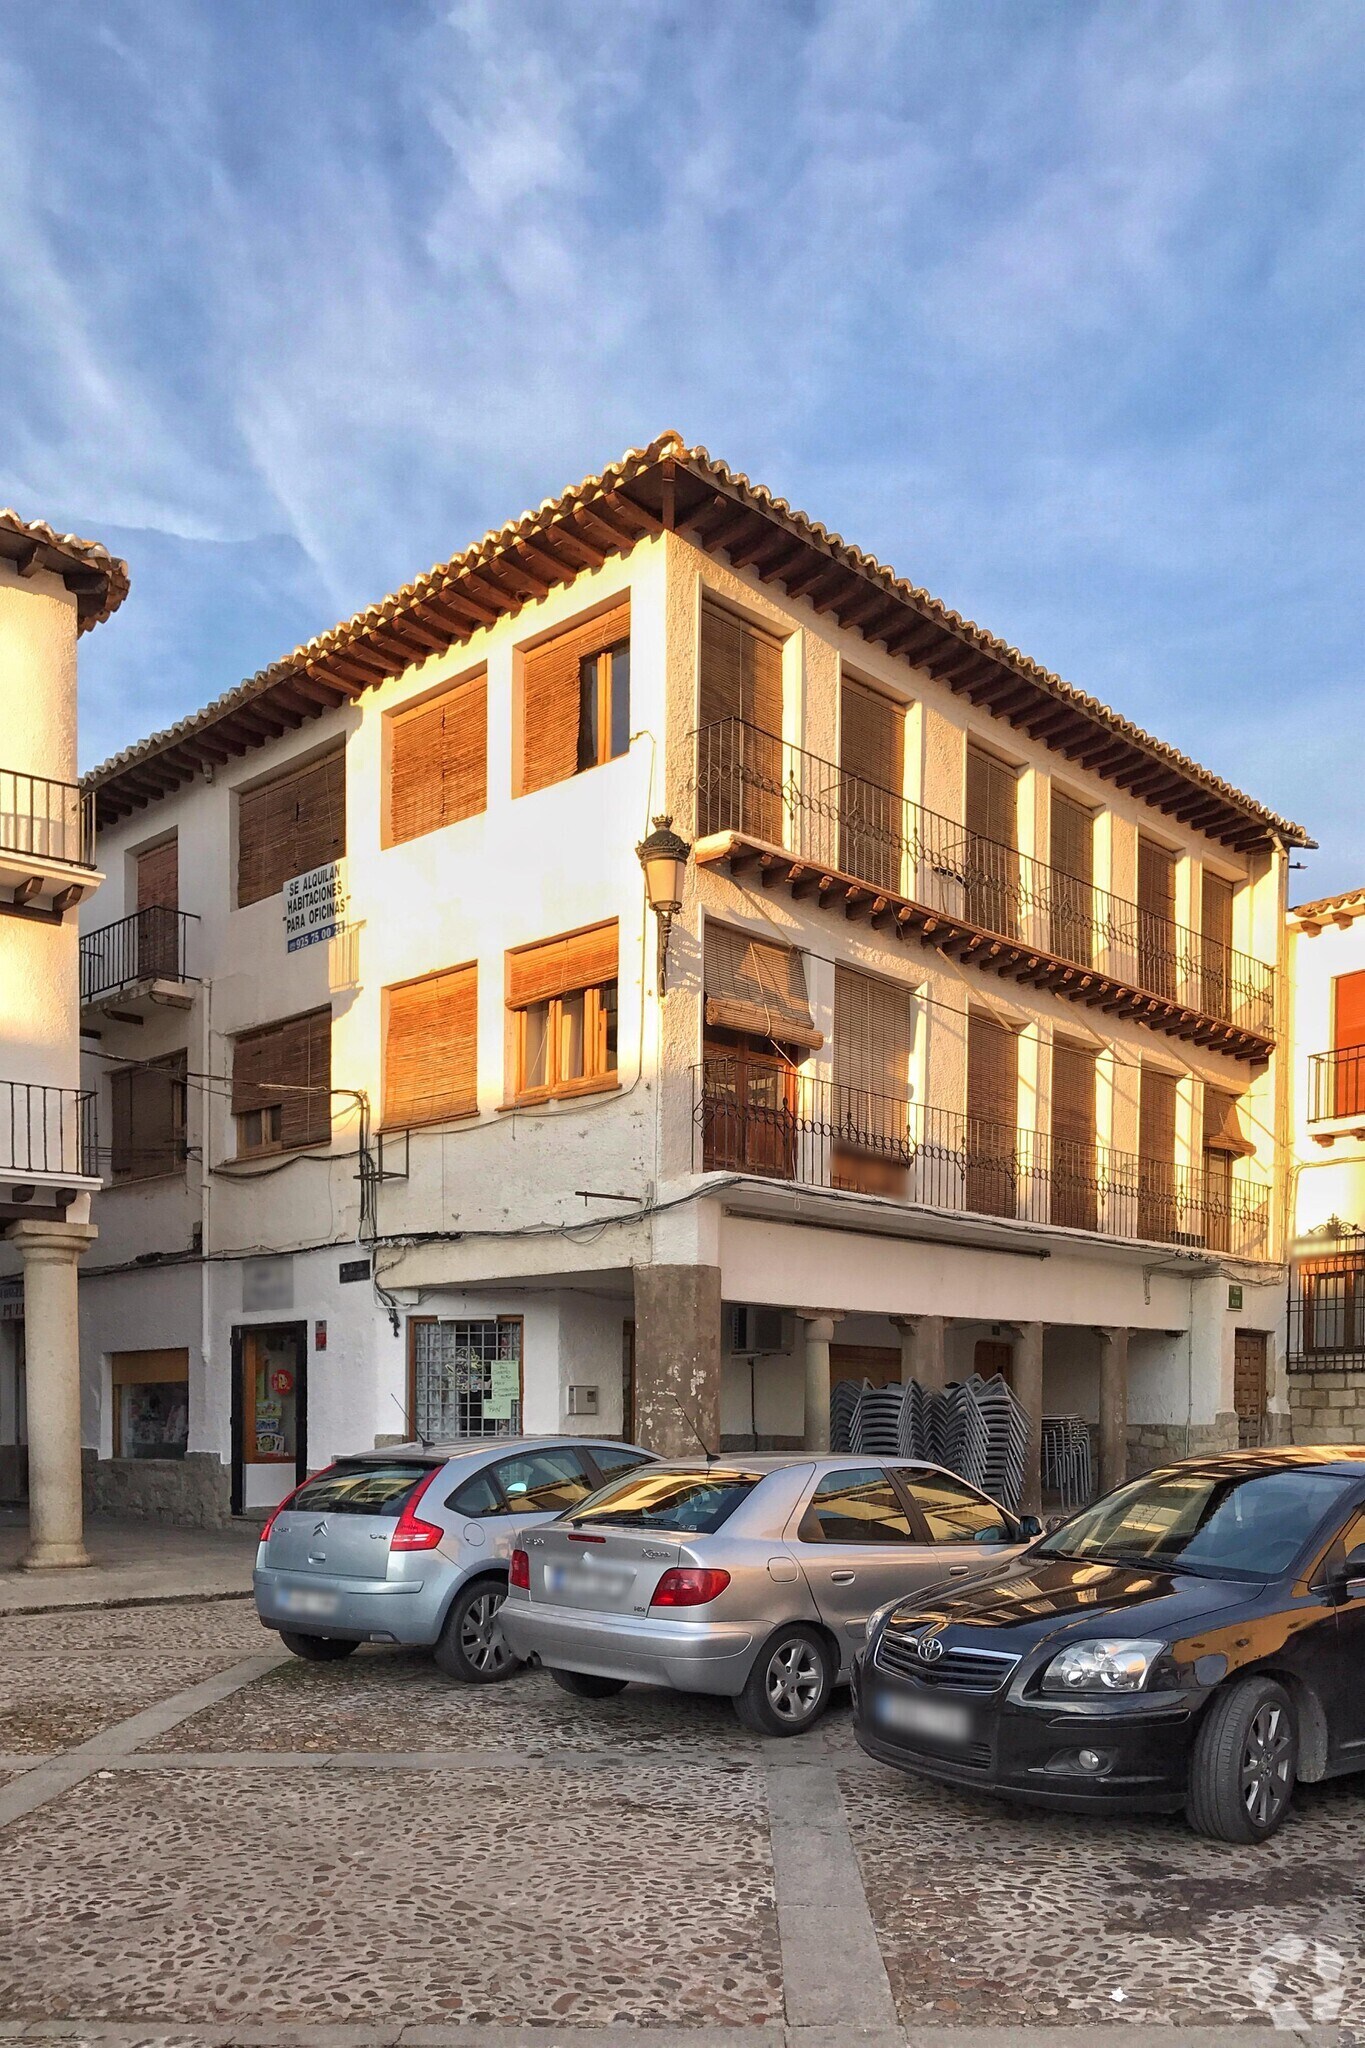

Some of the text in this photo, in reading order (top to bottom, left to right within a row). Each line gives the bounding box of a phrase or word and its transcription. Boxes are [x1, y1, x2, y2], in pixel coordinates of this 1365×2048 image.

[289, 864, 340, 896] SE ALQUILAN
[287, 880, 343, 915] HABITACIONES
[287, 898, 345, 933] PARA OFICINAS
[296, 937, 309, 949] 925
[311, 931, 320, 943] 75
[321, 927, 331, 938] 00
